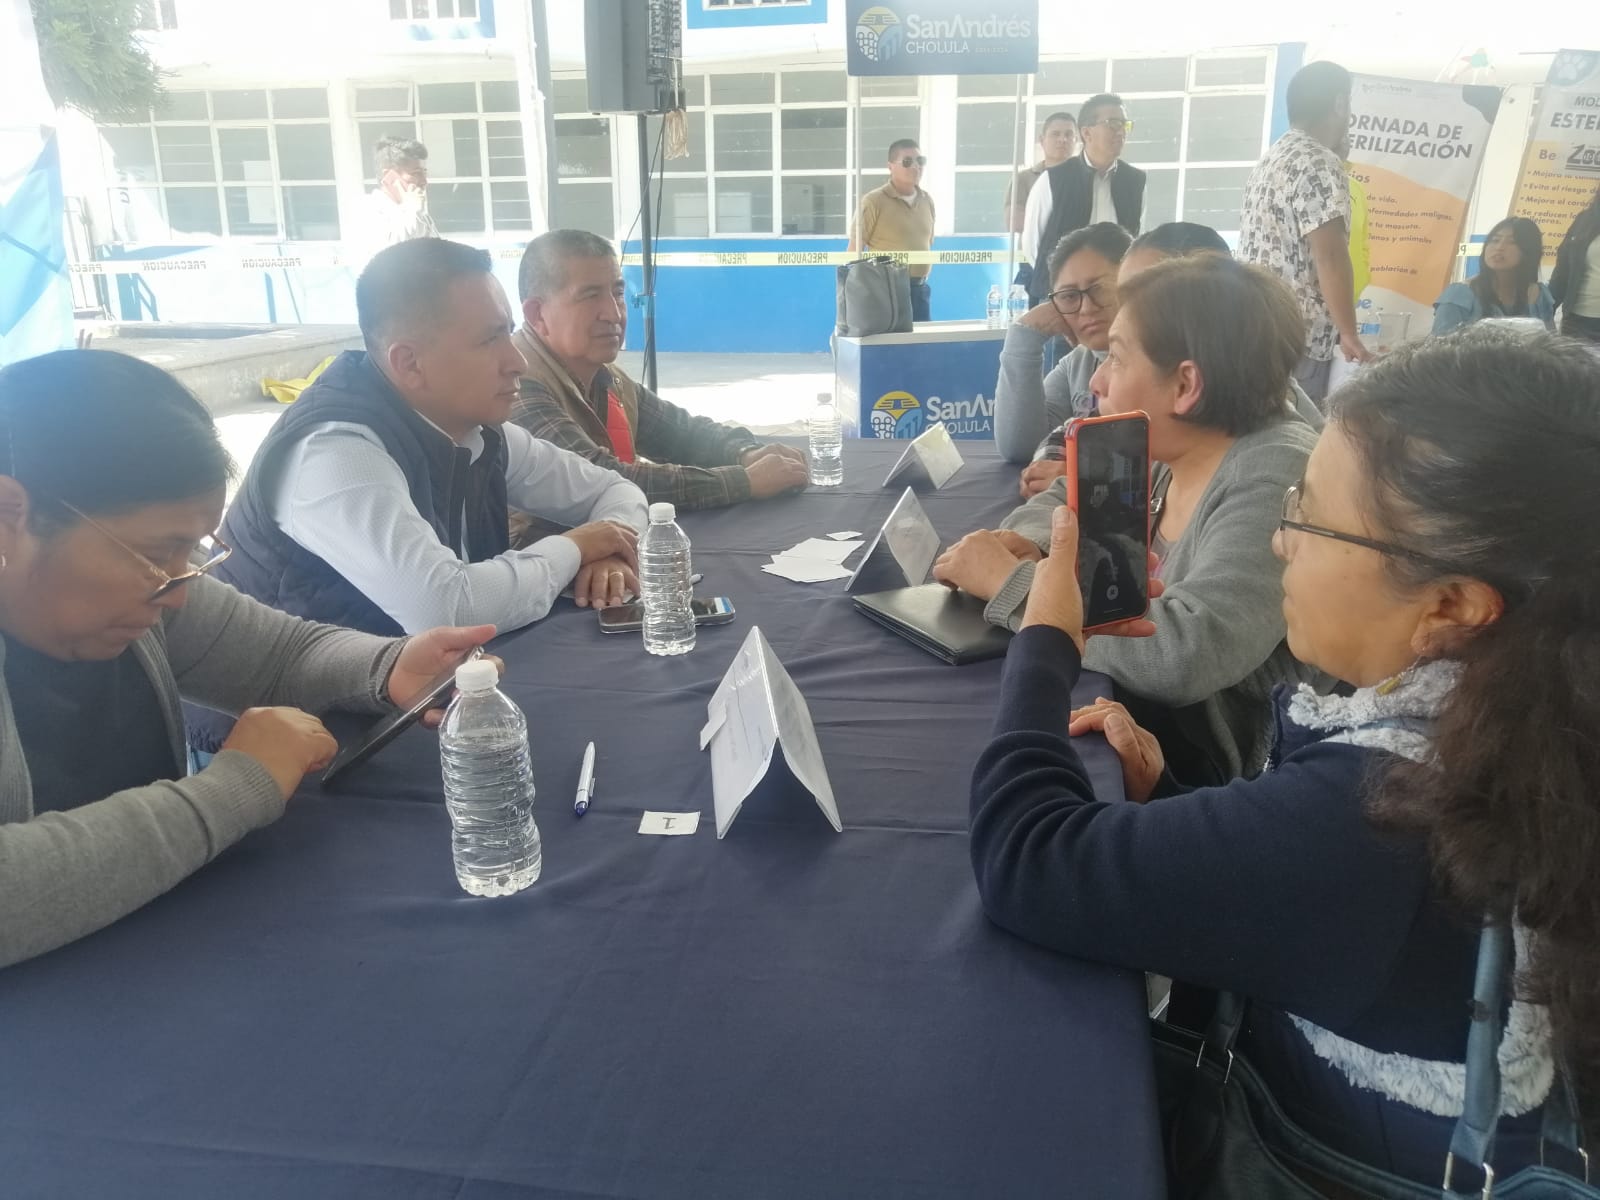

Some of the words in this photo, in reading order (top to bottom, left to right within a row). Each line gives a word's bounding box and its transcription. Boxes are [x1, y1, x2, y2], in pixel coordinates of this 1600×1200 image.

[907, 14, 1031, 39] SanAndrés
[906, 41, 970, 54] CHOLULA
[1349, 114, 1429, 137] ORNADA
[1437, 123, 1463, 140] DE
[1551, 112, 1600, 130] ESTE
[1348, 134, 1473, 159] ERILIZACIÓN
[1539, 149, 1557, 160] Be
[926, 420, 990, 434] COLULA
